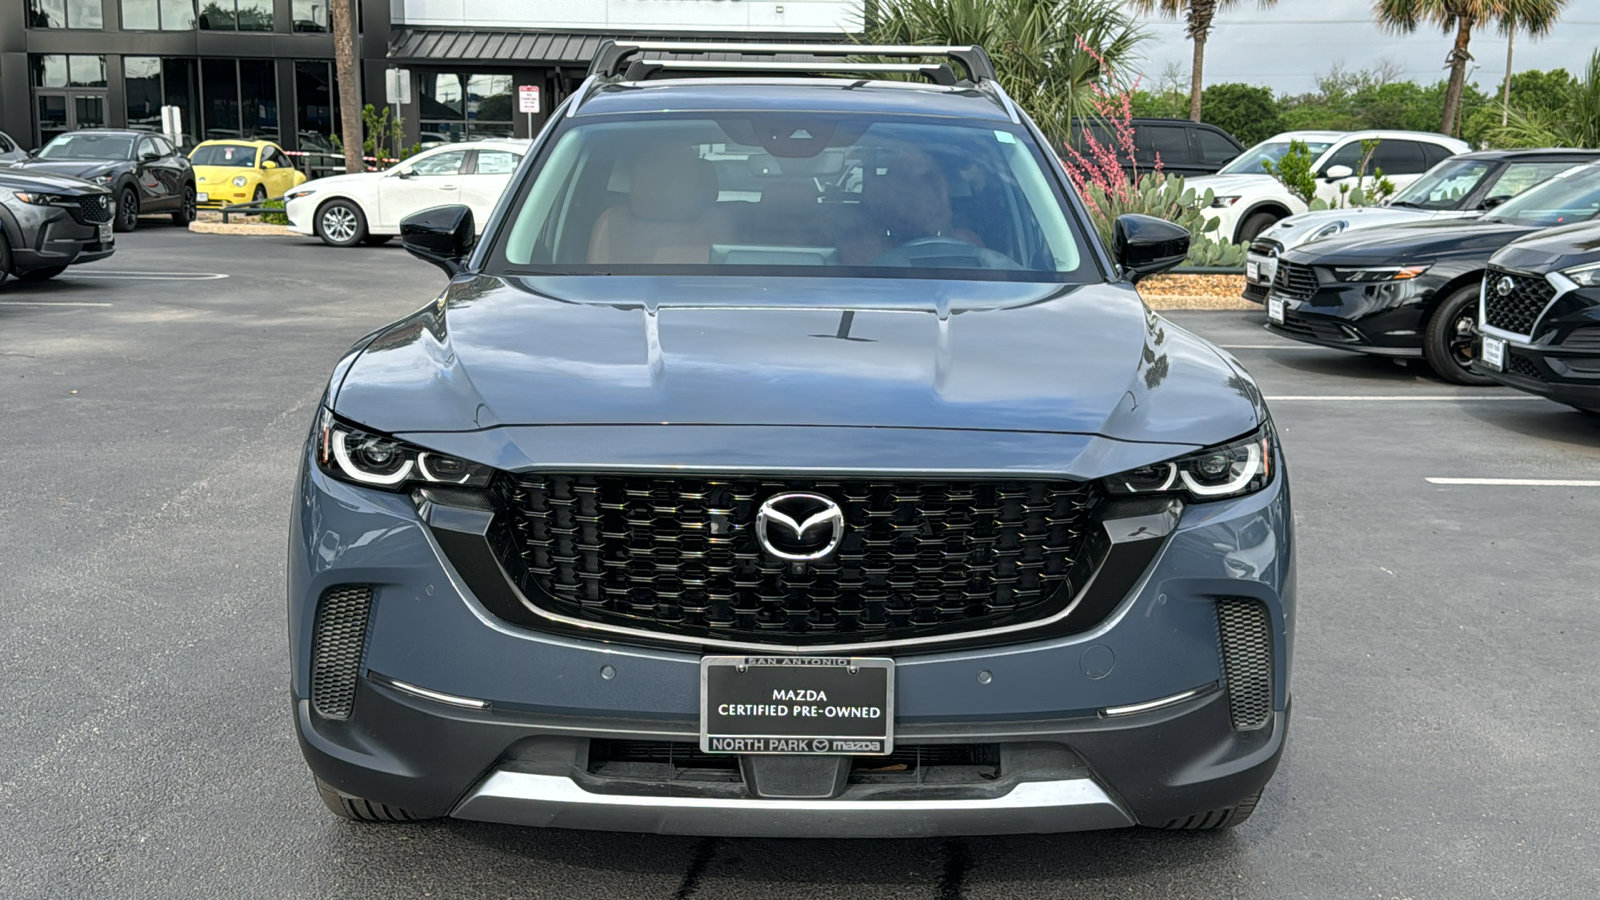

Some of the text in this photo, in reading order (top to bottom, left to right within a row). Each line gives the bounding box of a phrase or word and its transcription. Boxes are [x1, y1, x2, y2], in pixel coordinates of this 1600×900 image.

[748, 658, 848, 666] SAN ANTONIO
[772, 690, 827, 702] MAZDA
[718, 704, 880, 718] CERTIFIED PRE-OWNED
[712, 738, 880, 751] NORTH PARK mazda
